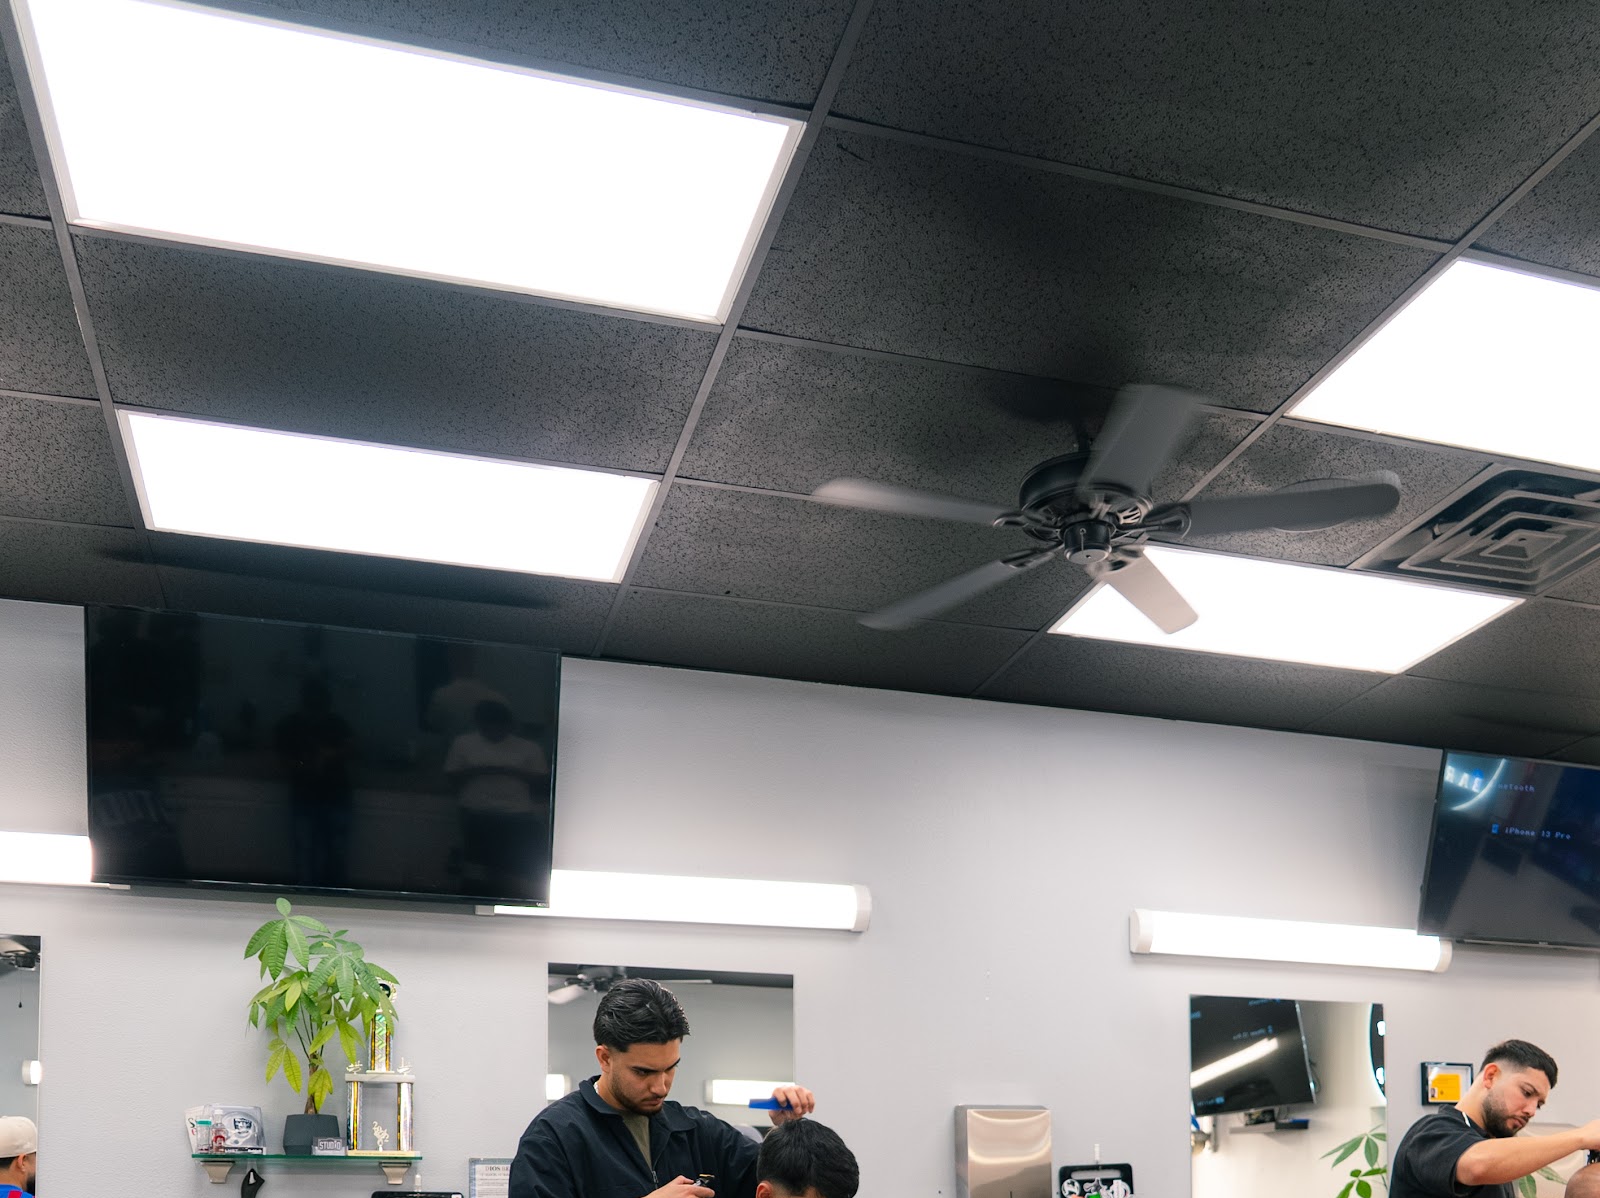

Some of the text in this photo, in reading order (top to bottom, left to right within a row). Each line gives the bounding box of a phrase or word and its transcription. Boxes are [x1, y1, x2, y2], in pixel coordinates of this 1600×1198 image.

[1505, 826, 1571, 840] iPhone 13 Pro
